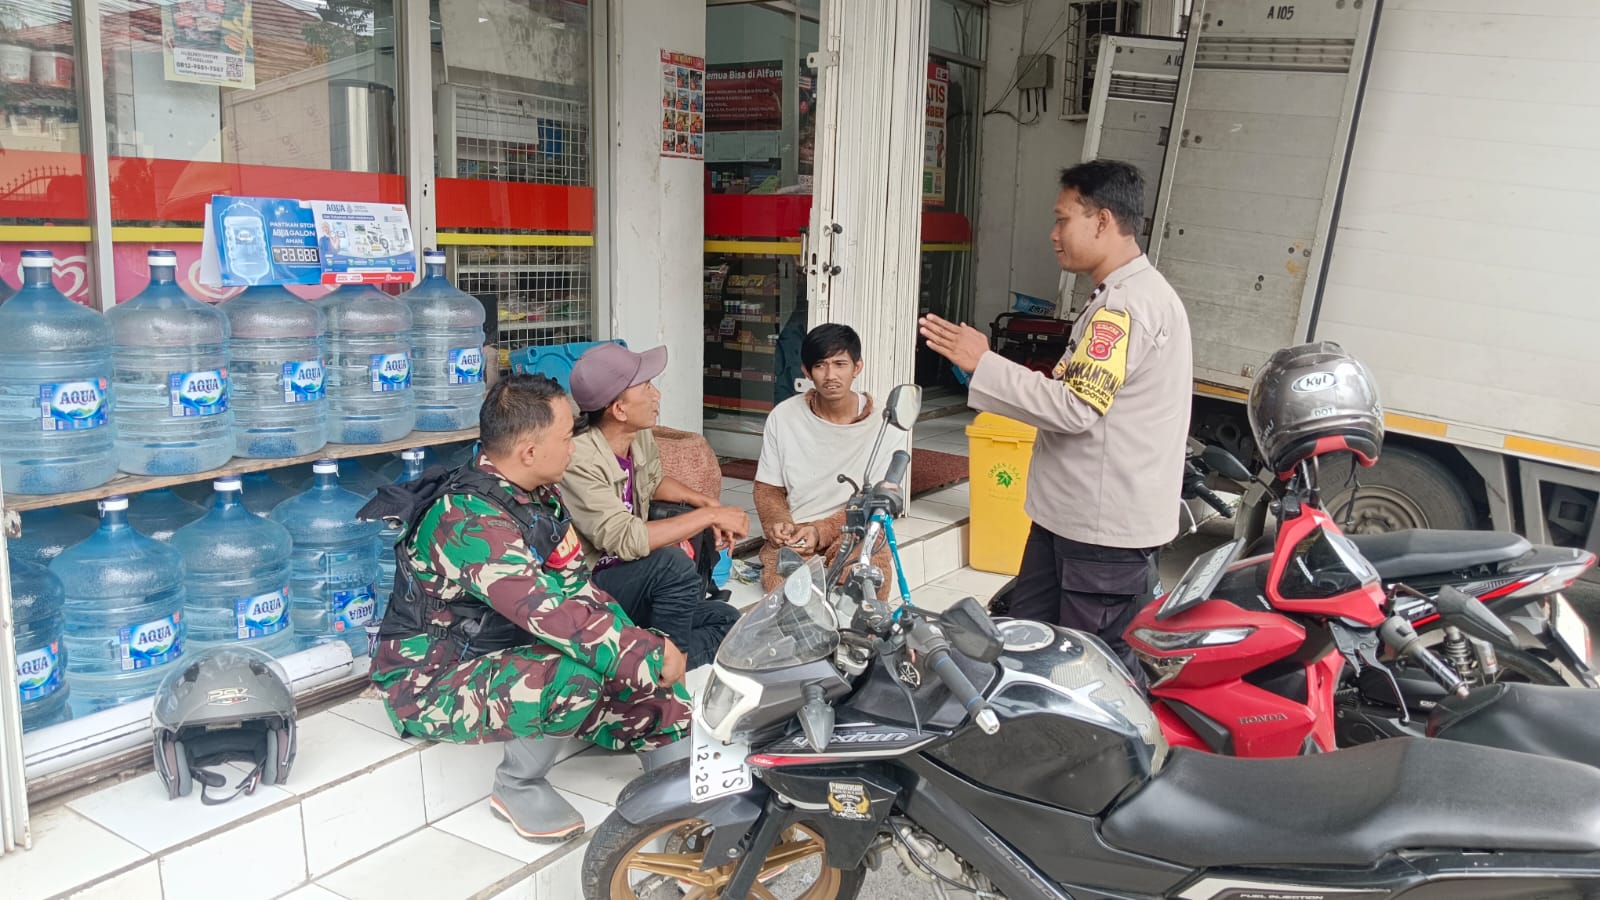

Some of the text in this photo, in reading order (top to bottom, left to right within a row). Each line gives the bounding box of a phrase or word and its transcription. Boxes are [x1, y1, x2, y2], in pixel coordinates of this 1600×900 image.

[1267, 6, 1295, 20] A 105
[729, 70, 746, 79] Bisa
[747, 69, 755, 78] di
[326, 204, 346, 213] AQUA
[384, 359, 408, 373] AQUA
[461, 354, 481, 367] AQUA
[297, 366, 322, 381] AQUA
[187, 378, 220, 394] AQUA
[59, 389, 98, 406] AQUA
[1314, 407, 1333, 417] DOT
[252, 597, 282, 616] AQUA
[348, 603, 374, 620] AQUA
[137, 625, 172, 645] AQUA
[1238, 713, 1289, 726] HONDA
[722, 764, 744, 789] TS
